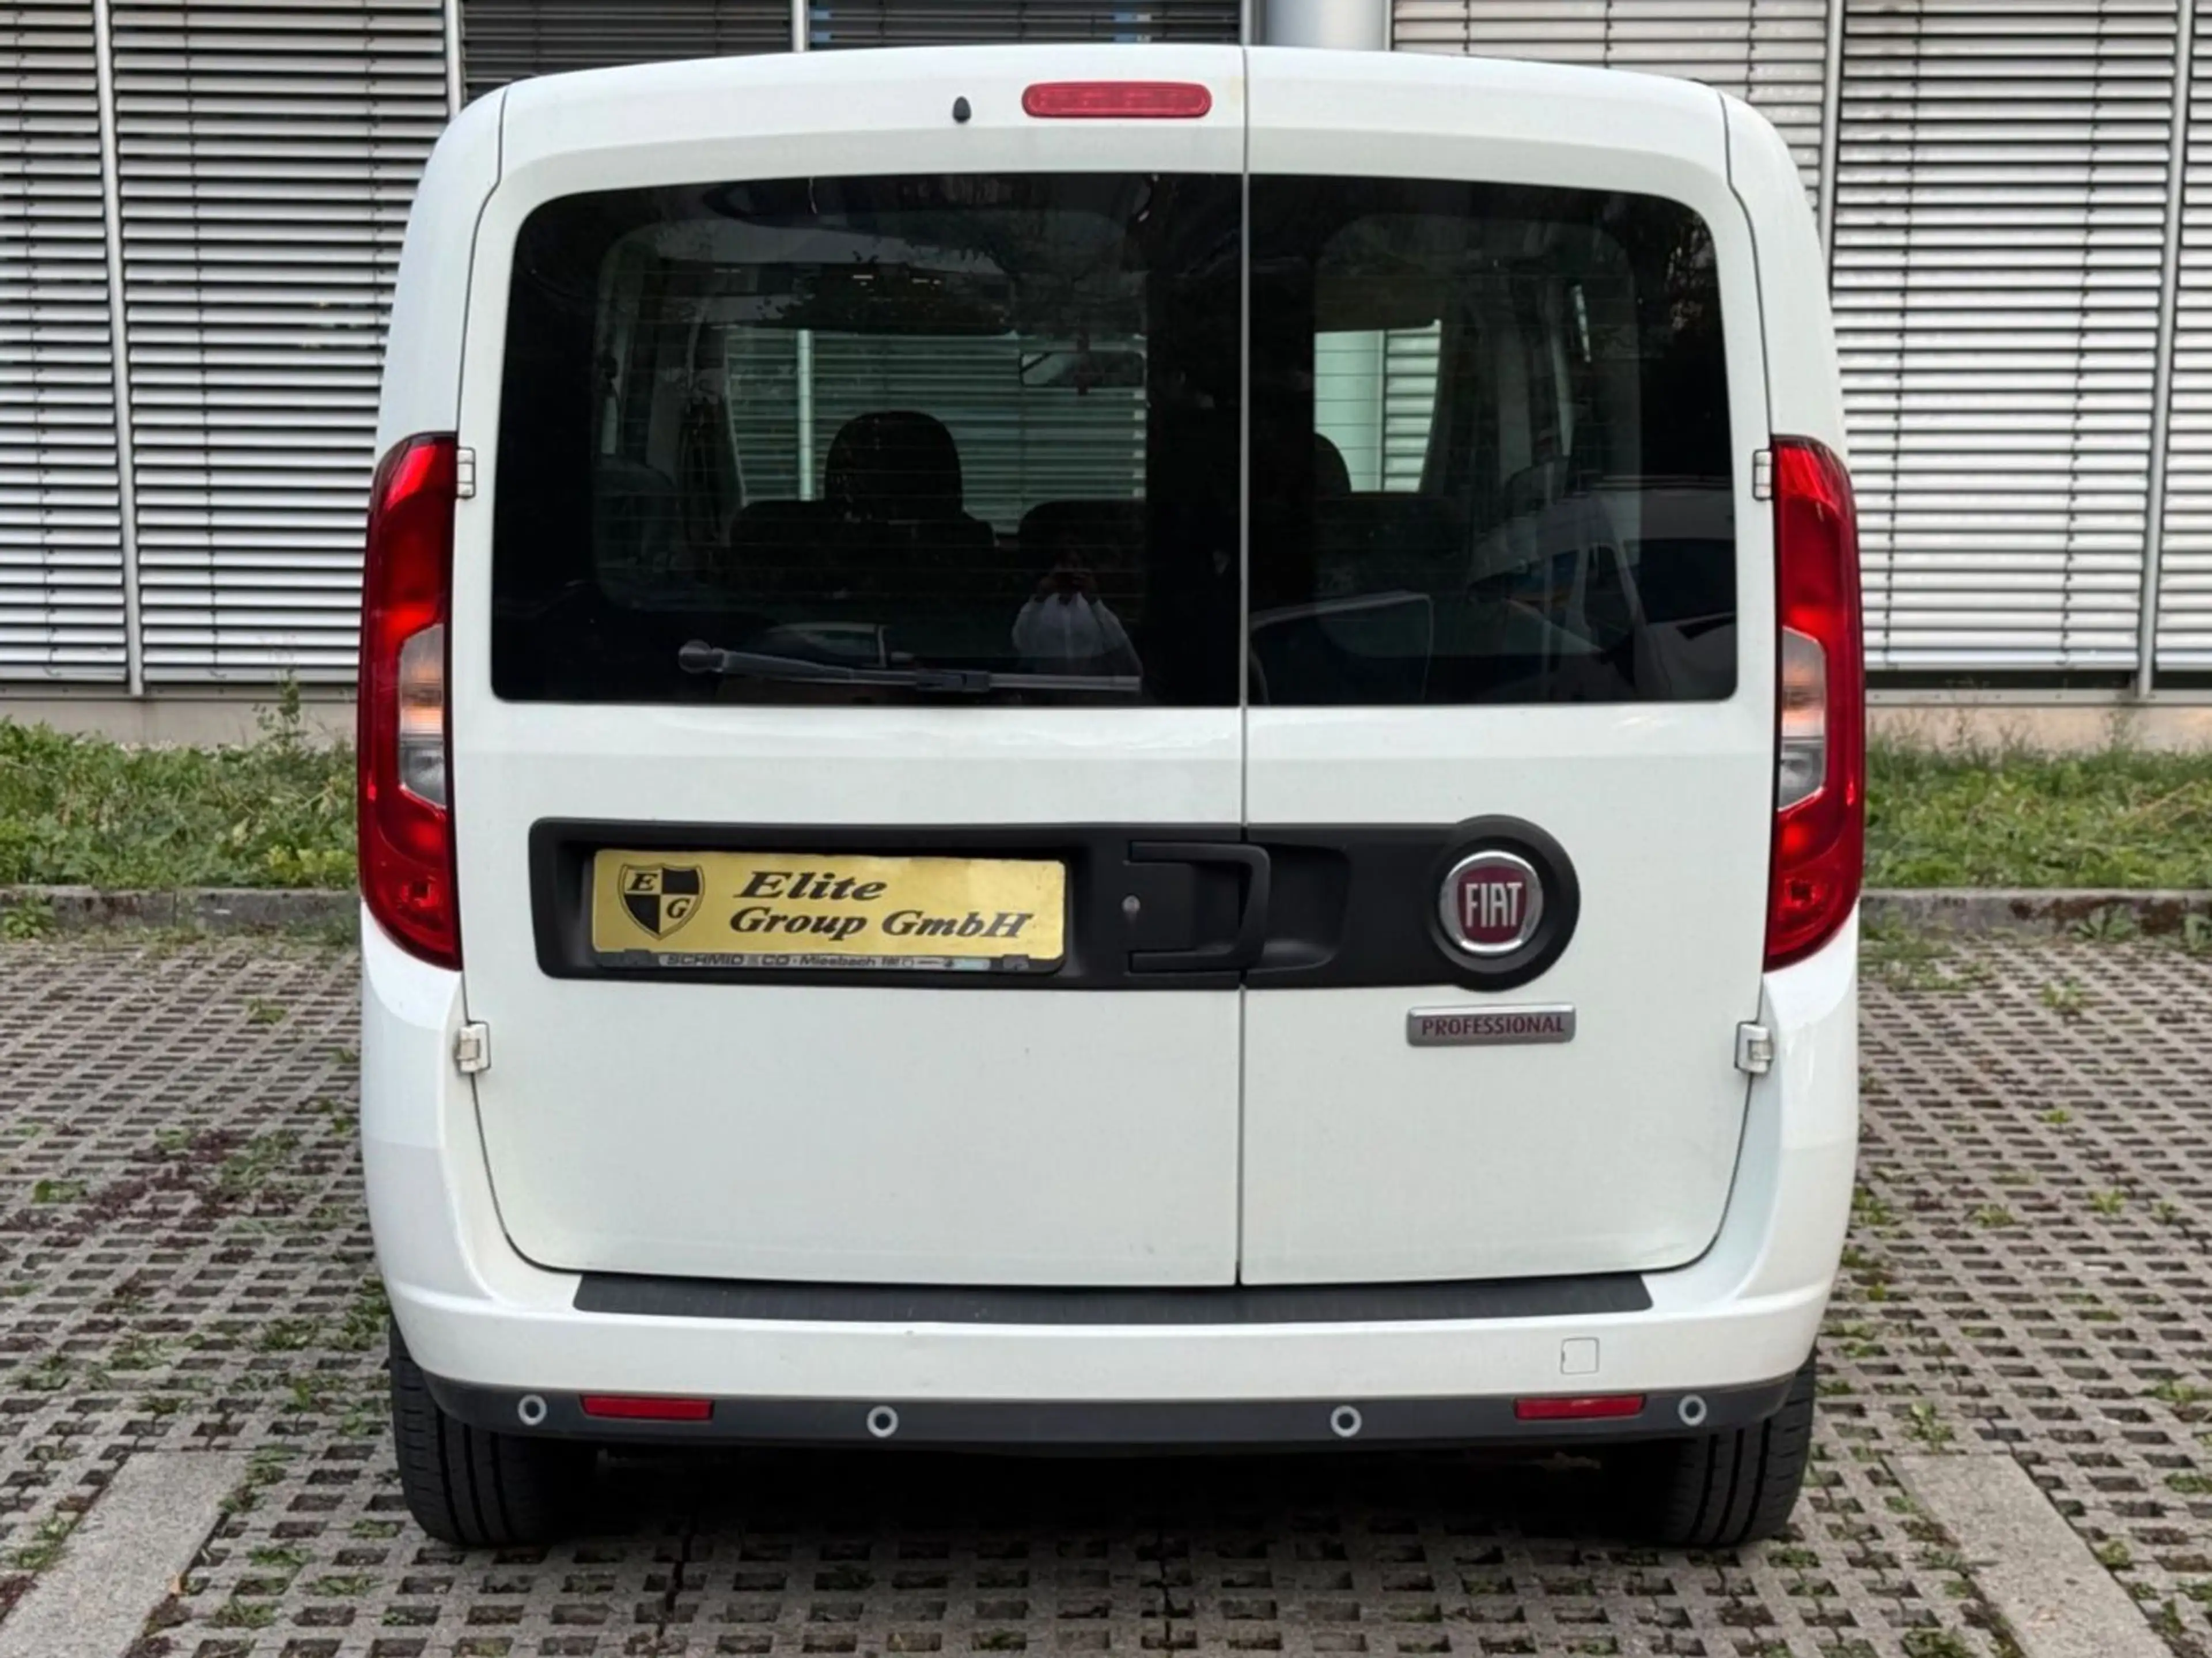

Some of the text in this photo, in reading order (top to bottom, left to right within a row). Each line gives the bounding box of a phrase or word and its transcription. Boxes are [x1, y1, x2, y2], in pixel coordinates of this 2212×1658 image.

[628, 873, 658, 891] E
[734, 871, 887, 900] Elite
[666, 898, 691, 919] G
[1465, 882, 1522, 928] FIAT
[730, 906, 1033, 940] Group GmbH
[1422, 1016, 1564, 1035] PROFESSIONAL
